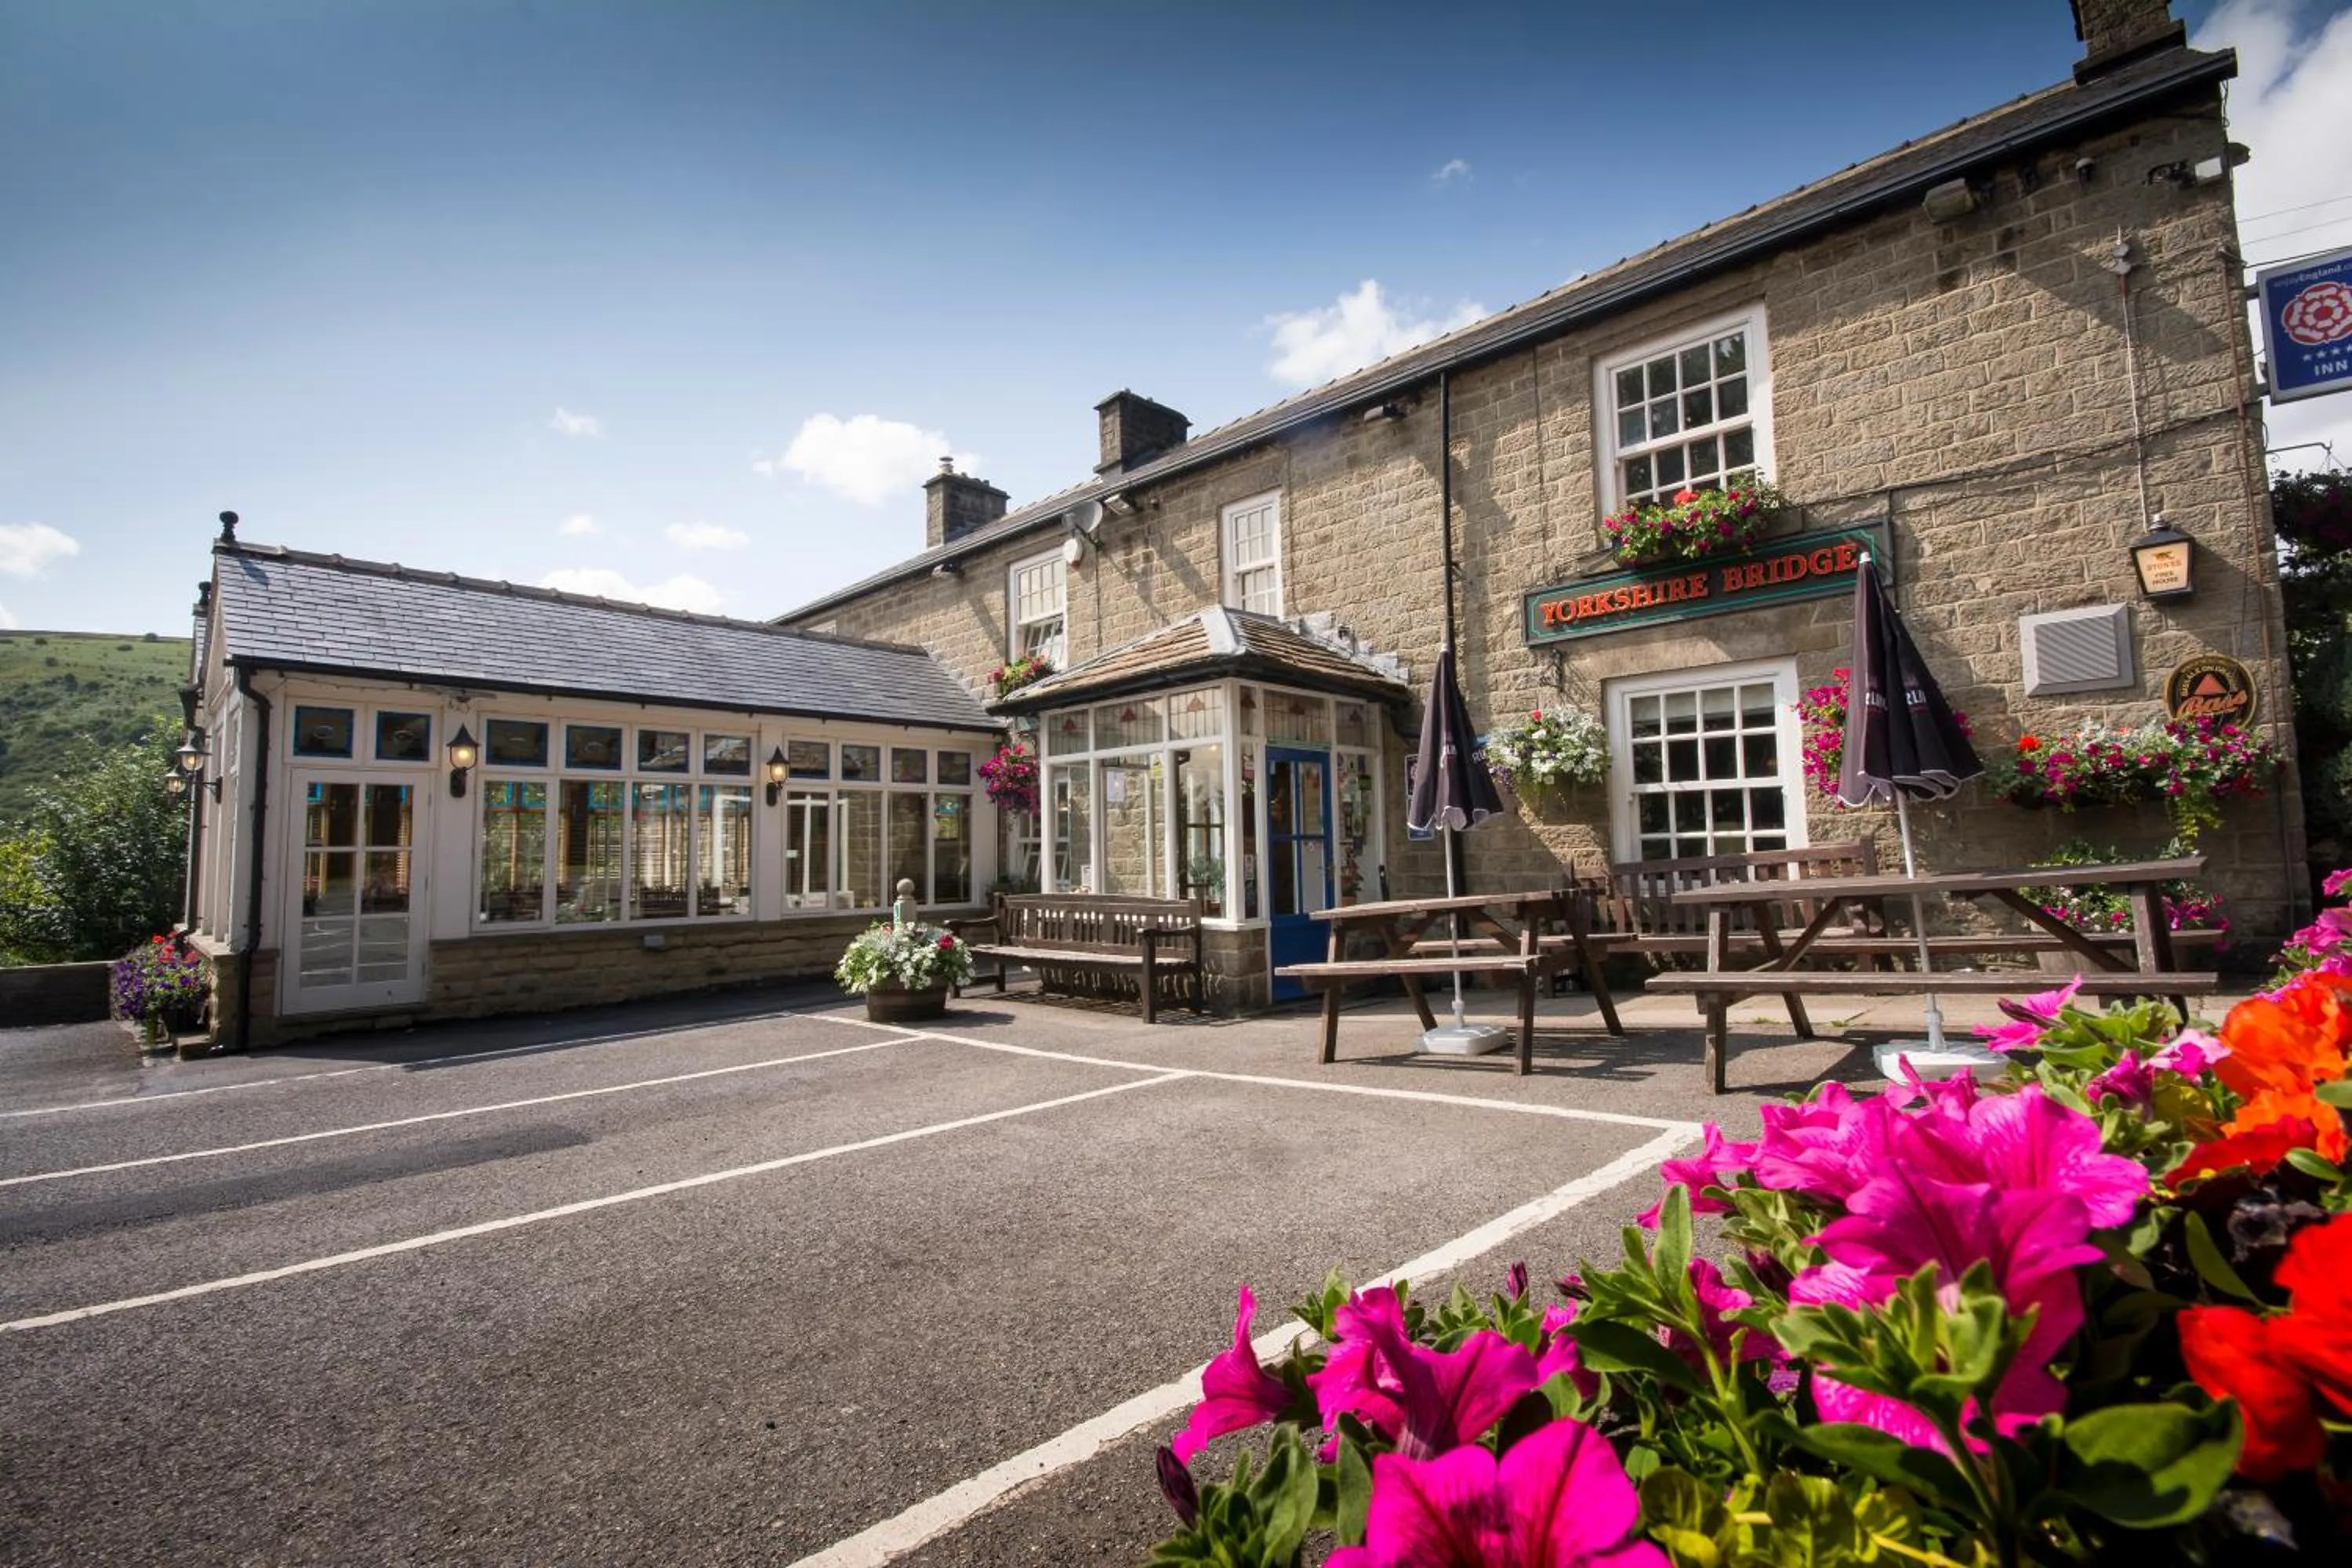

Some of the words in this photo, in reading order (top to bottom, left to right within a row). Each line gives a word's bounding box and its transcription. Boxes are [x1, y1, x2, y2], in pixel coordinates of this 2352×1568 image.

[2314, 360, 2348, 376] INN
[1539, 571, 1709, 624] YORKSHIRE
[1721, 543, 1859, 593] BRIDGE
[2152, 576, 2178, 586] HOUSE
